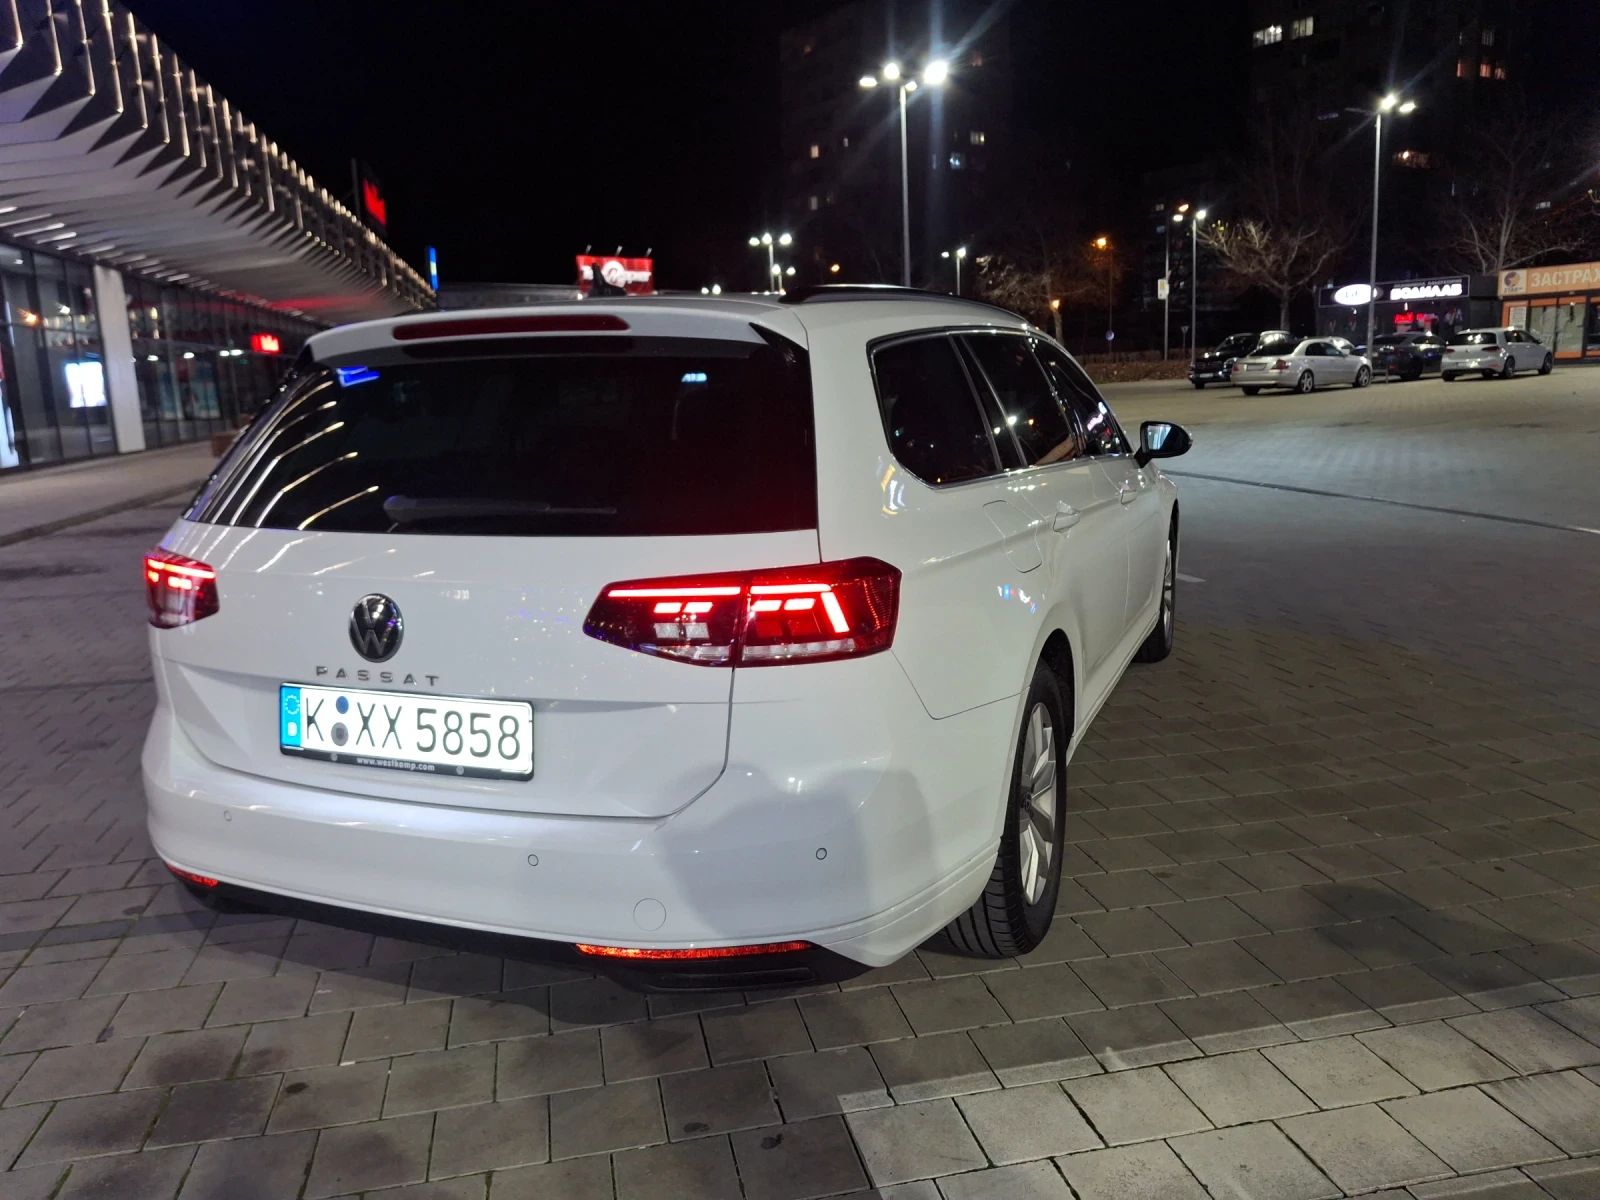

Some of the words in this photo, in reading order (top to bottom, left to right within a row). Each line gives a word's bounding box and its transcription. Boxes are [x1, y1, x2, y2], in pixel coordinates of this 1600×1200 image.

[315, 665, 440, 687] PASSAT
[305, 697, 325, 742] K
[355, 702, 403, 751] XX
[416, 707, 521, 761] 5858
[356, 757, 435, 772] www.westkamp.com
